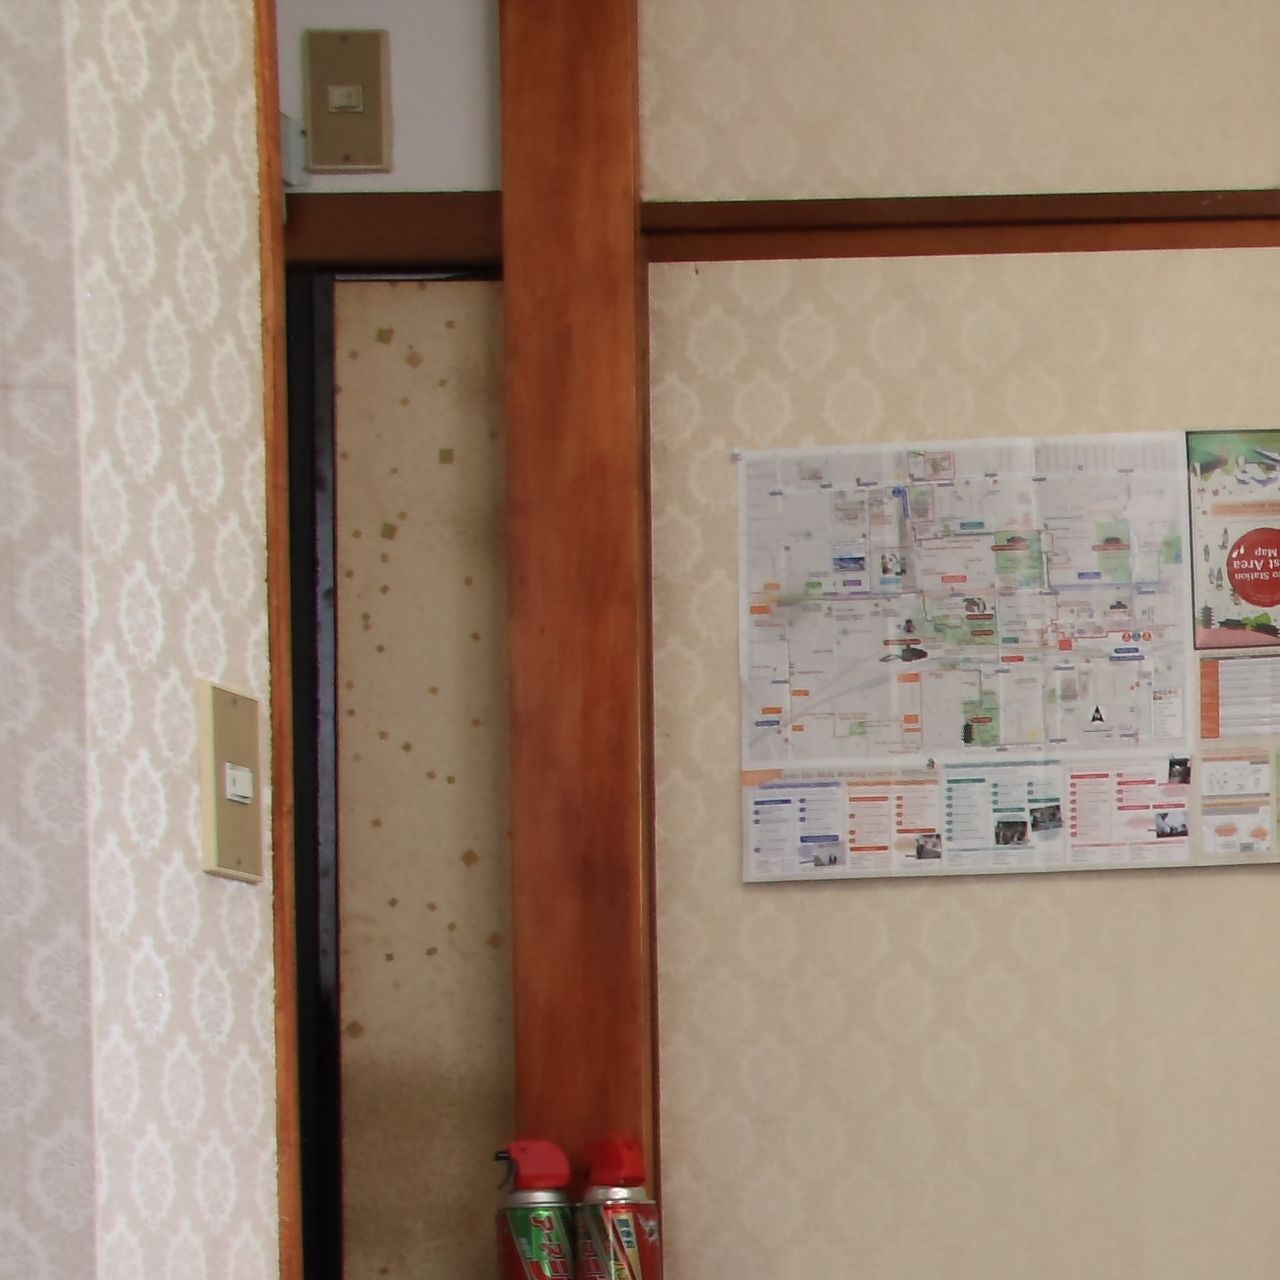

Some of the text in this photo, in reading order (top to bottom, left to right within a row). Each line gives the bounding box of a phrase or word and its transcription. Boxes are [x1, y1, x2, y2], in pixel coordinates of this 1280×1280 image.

[1254, 547, 1278, 557] Map
[1232, 559, 1264, 571] Area
[1235, 571, 1269, 581] Station
